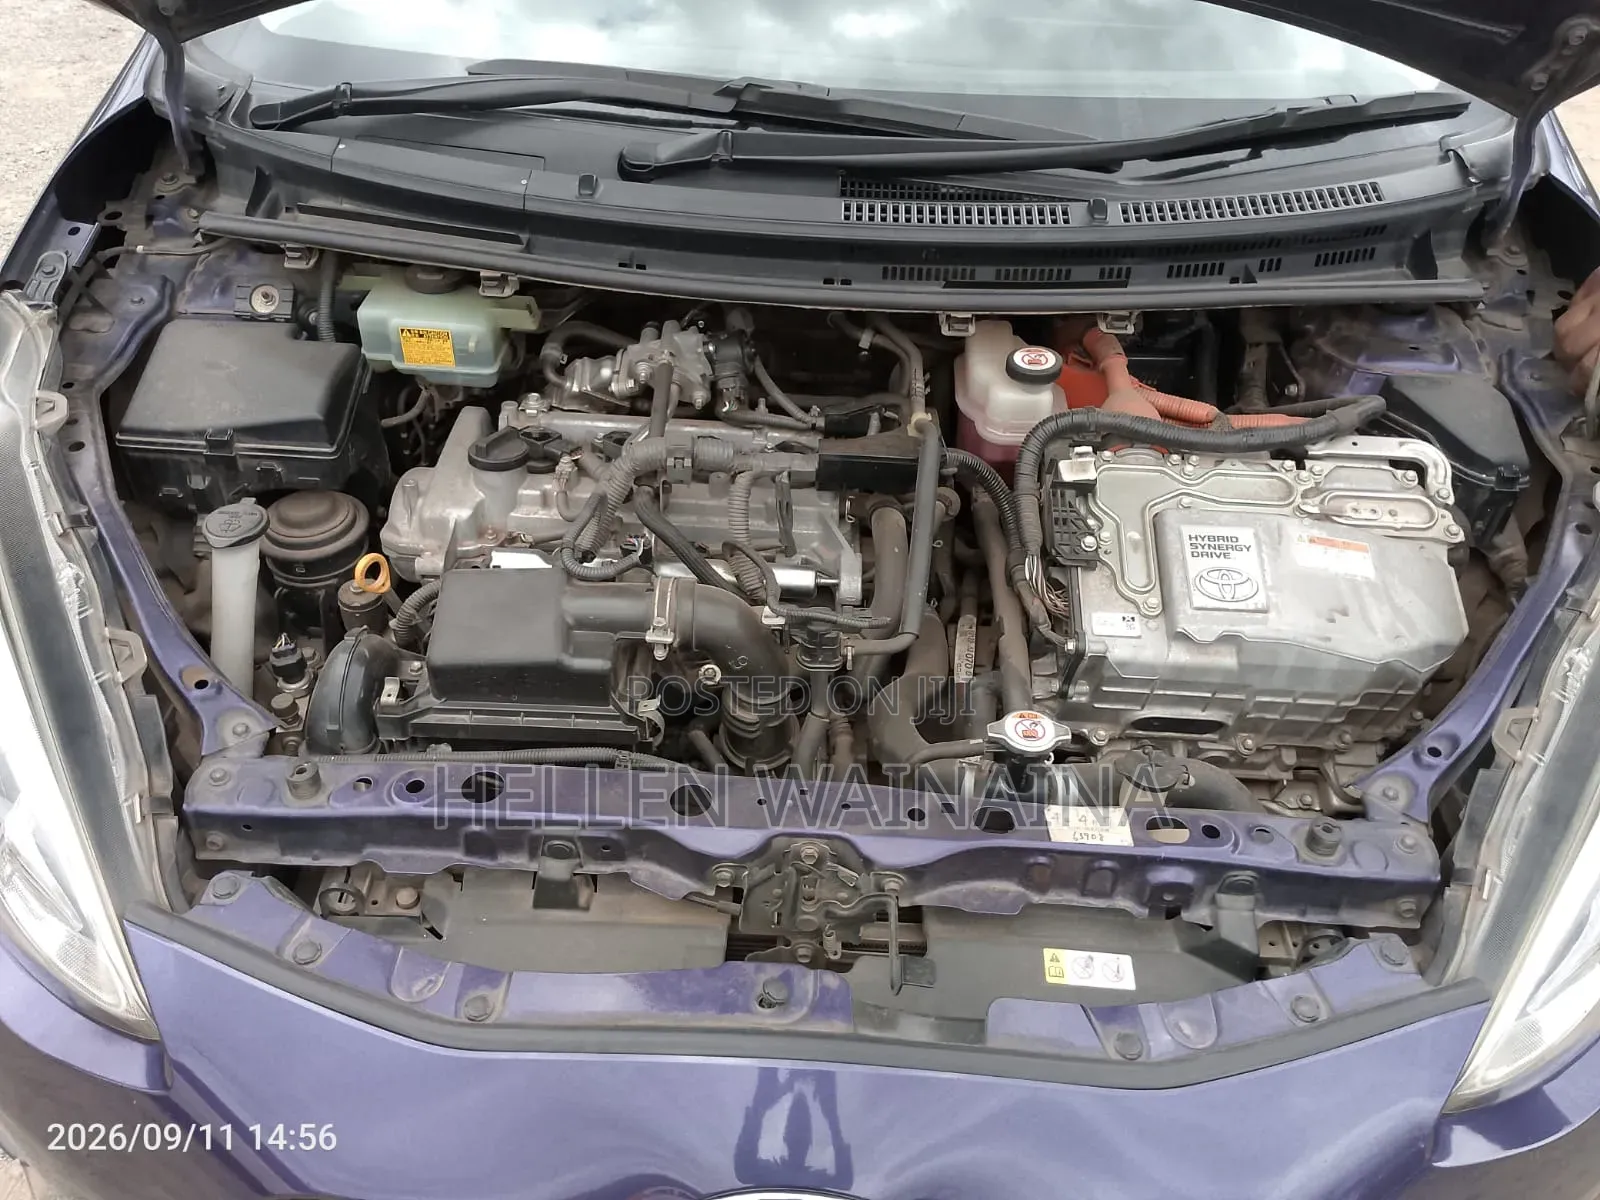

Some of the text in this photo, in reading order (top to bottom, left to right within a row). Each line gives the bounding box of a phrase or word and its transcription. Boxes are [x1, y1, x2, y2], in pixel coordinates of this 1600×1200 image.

[1188, 534, 1239, 543] HYBRID
[1189, 542, 1252, 552] SYNERGY
[1190, 551, 1232, 559] DRIVE
